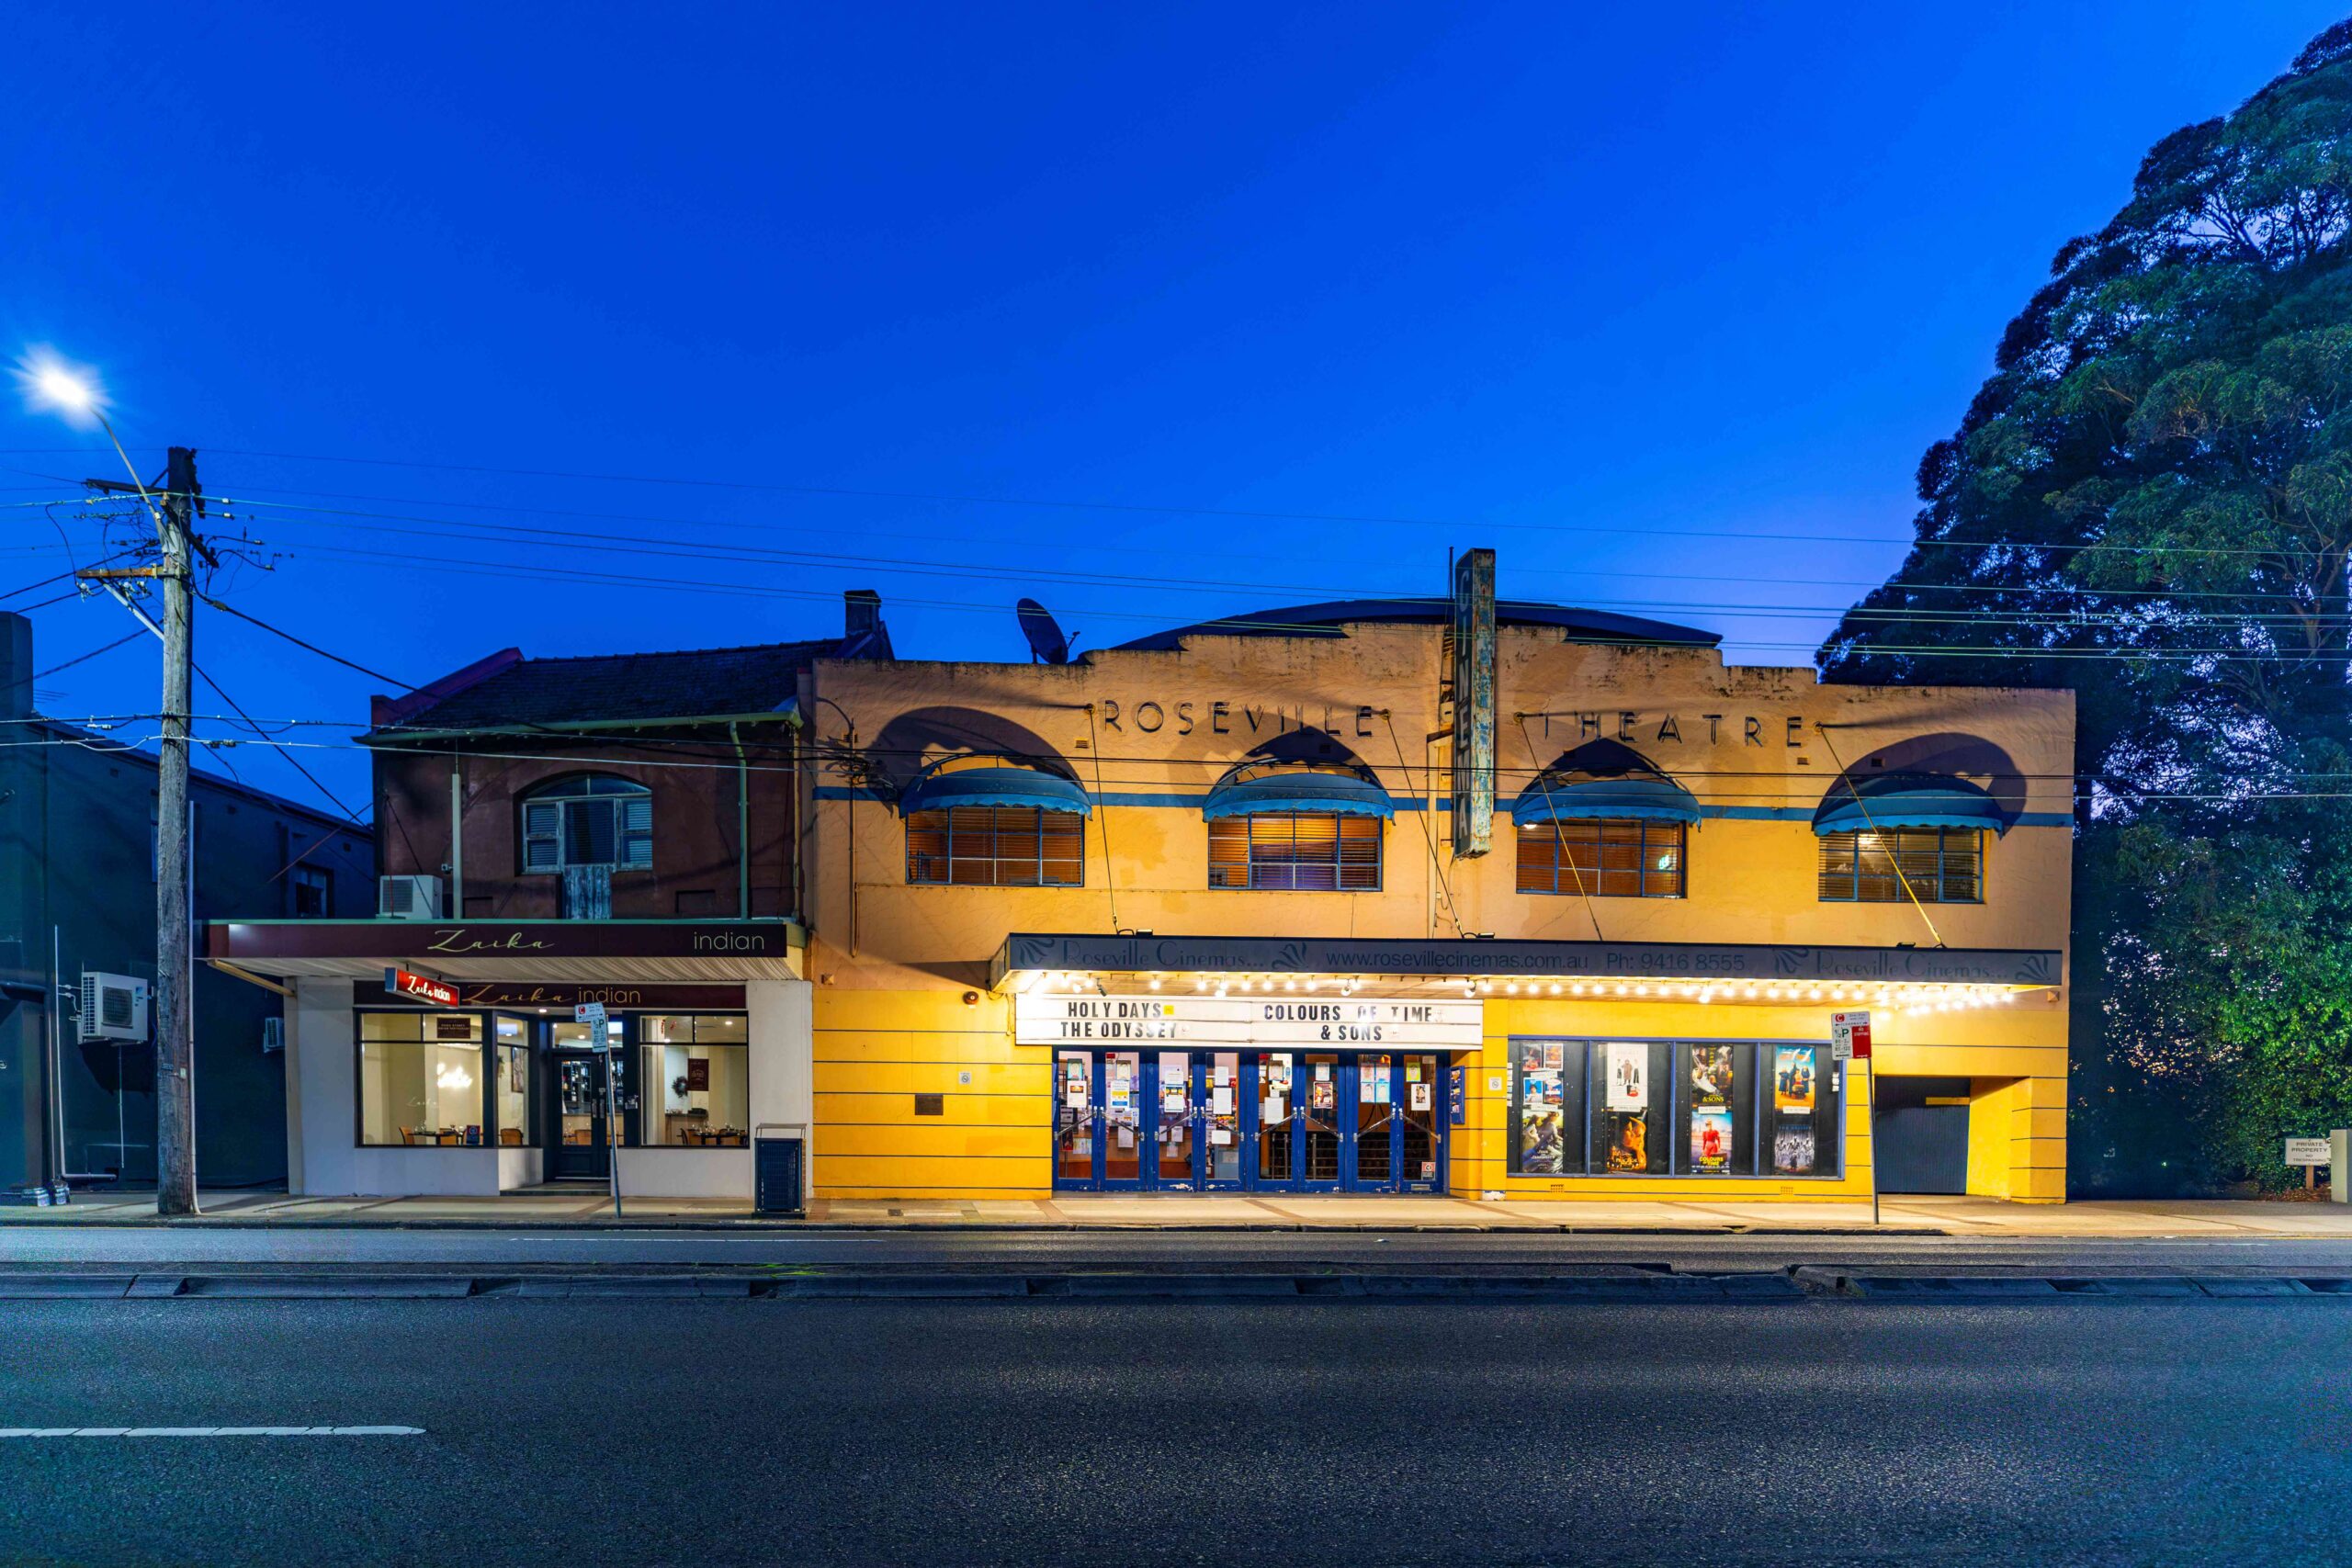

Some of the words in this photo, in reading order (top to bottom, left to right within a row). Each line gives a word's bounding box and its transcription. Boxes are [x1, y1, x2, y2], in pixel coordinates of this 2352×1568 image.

[1457, 570, 1470, 840] CINEMA
[1104, 699, 1374, 737] ROSEVILLE
[1539, 712, 1803, 747] THEATRE
[427, 930, 555, 953] Zaika
[693, 931, 764, 951] indian
[1062, 940, 1148, 964] Roseville
[1326, 950, 1589, 970] www.rosevillecinemas.com.au
[1607, 953, 1634, 970] Ph:
[1641, 953, 1690, 971] 9416
[1695, 954, 1746, 972] 8555
[1816, 952, 1898, 977] Roseville
[461, 984, 573, 1005] Zaika
[578, 986, 640, 1004] indian
[1068, 1002, 1111, 1017] HOLY
[1118, 1002, 1161, 1018] DAYS
[1264, 1005, 1341, 1021] COLOURS
[1391, 1006, 1432, 1021] TIME
[1061, 1021, 1091, 1037] THE
[1320, 1025, 1331, 1040] &
[1338, 1025, 1382, 1041] SONS
